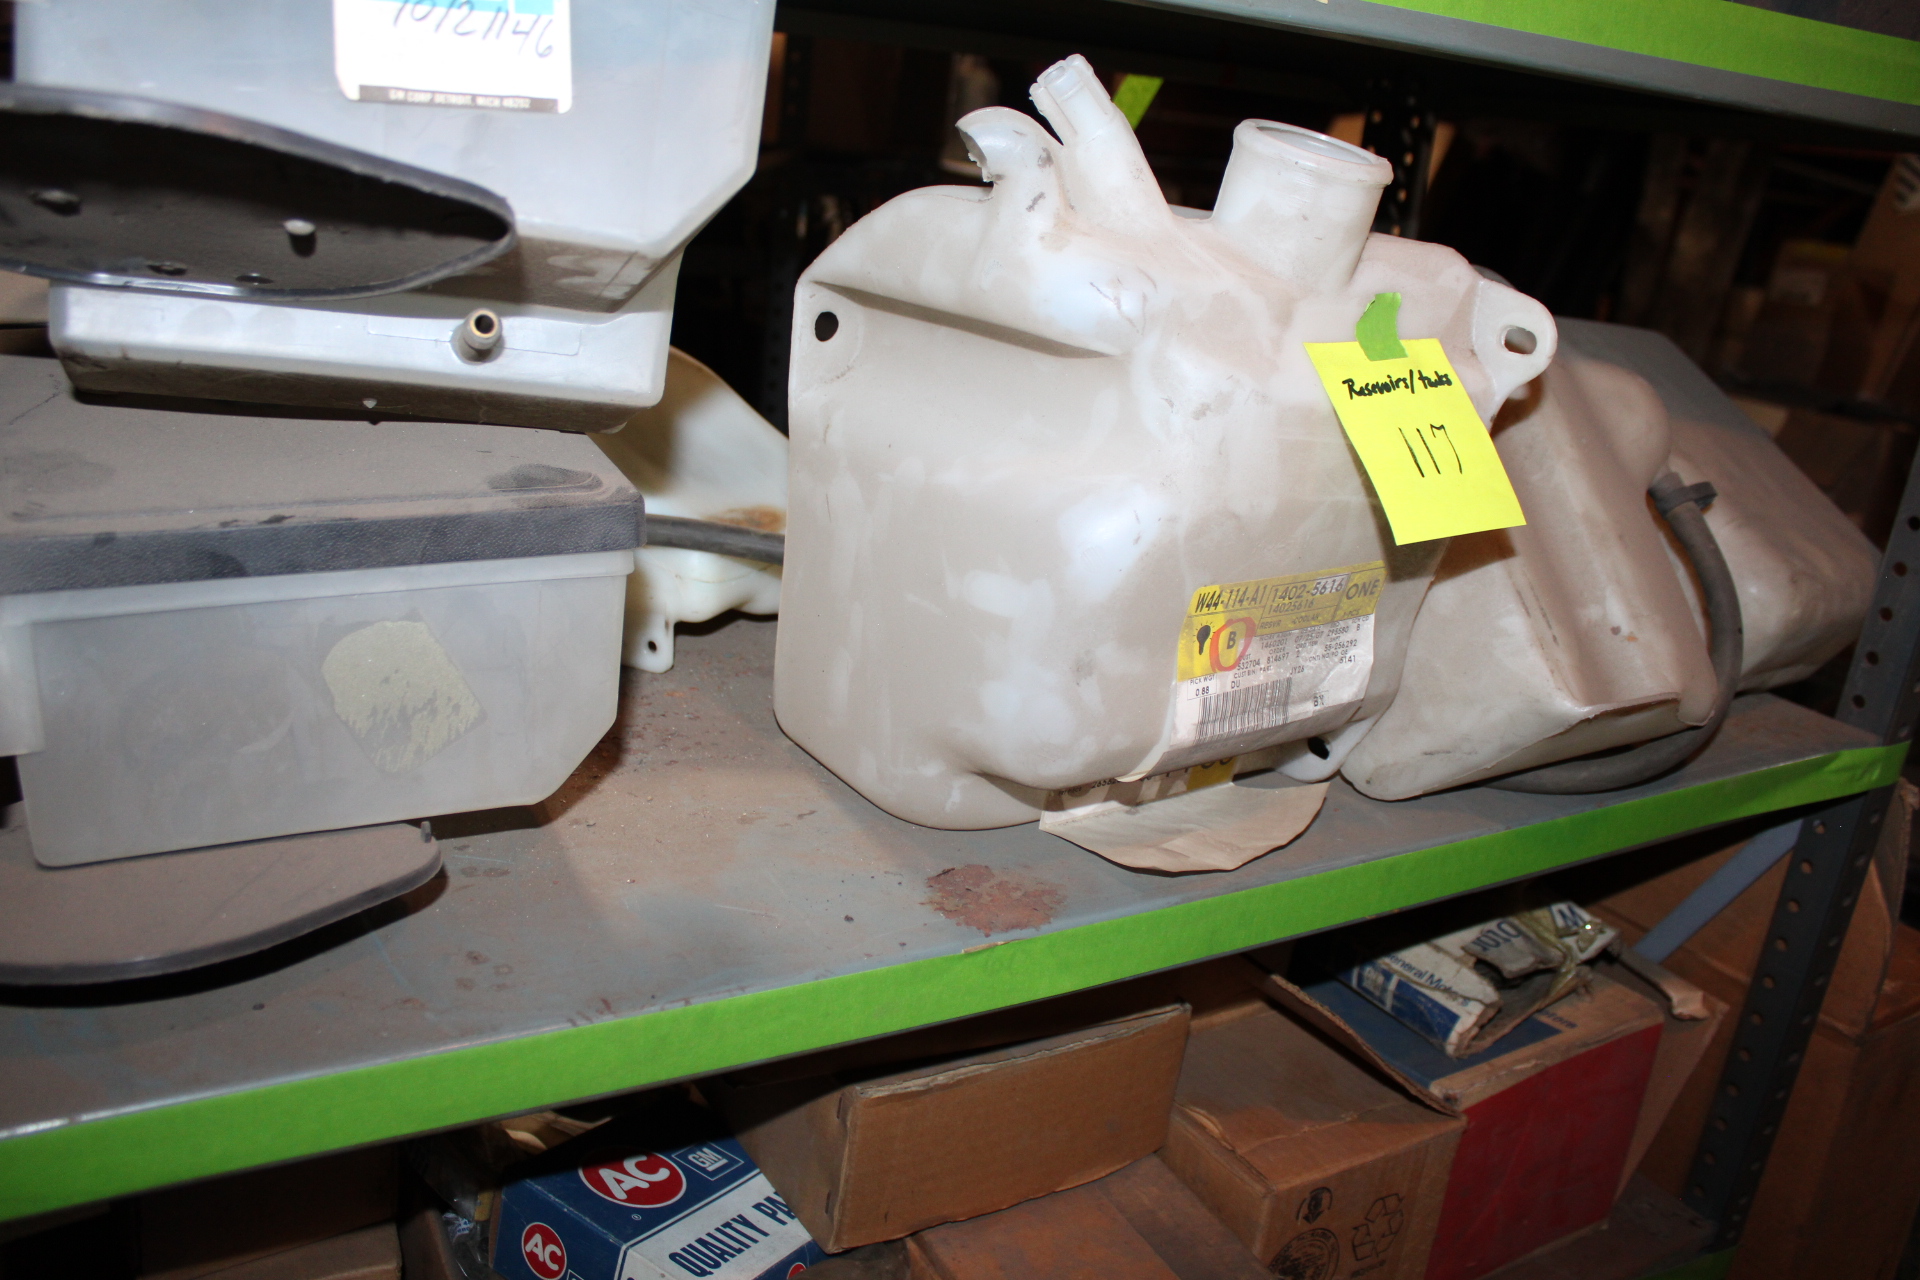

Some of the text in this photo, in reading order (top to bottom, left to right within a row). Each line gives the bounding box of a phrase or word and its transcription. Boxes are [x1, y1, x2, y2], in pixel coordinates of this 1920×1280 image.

[1398, 423, 1463, 478] 117
[1194, 578, 1380, 613] W44-114-A1 1402-5616 ONE
[1267, 601, 1315, 615] 14025616
[1226, 631, 1236, 649] B
[1266, 652, 1290, 665] 814697
[1339, 655, 1356, 664] 5141
[1189, 678, 1203, 686] PICK
[1230, 679, 1241, 689] DU
[598, 1146, 725, 1201] AC GM
[668, 1190, 797, 1278] QUALITY PA
[525, 1232, 563, 1271] AC
